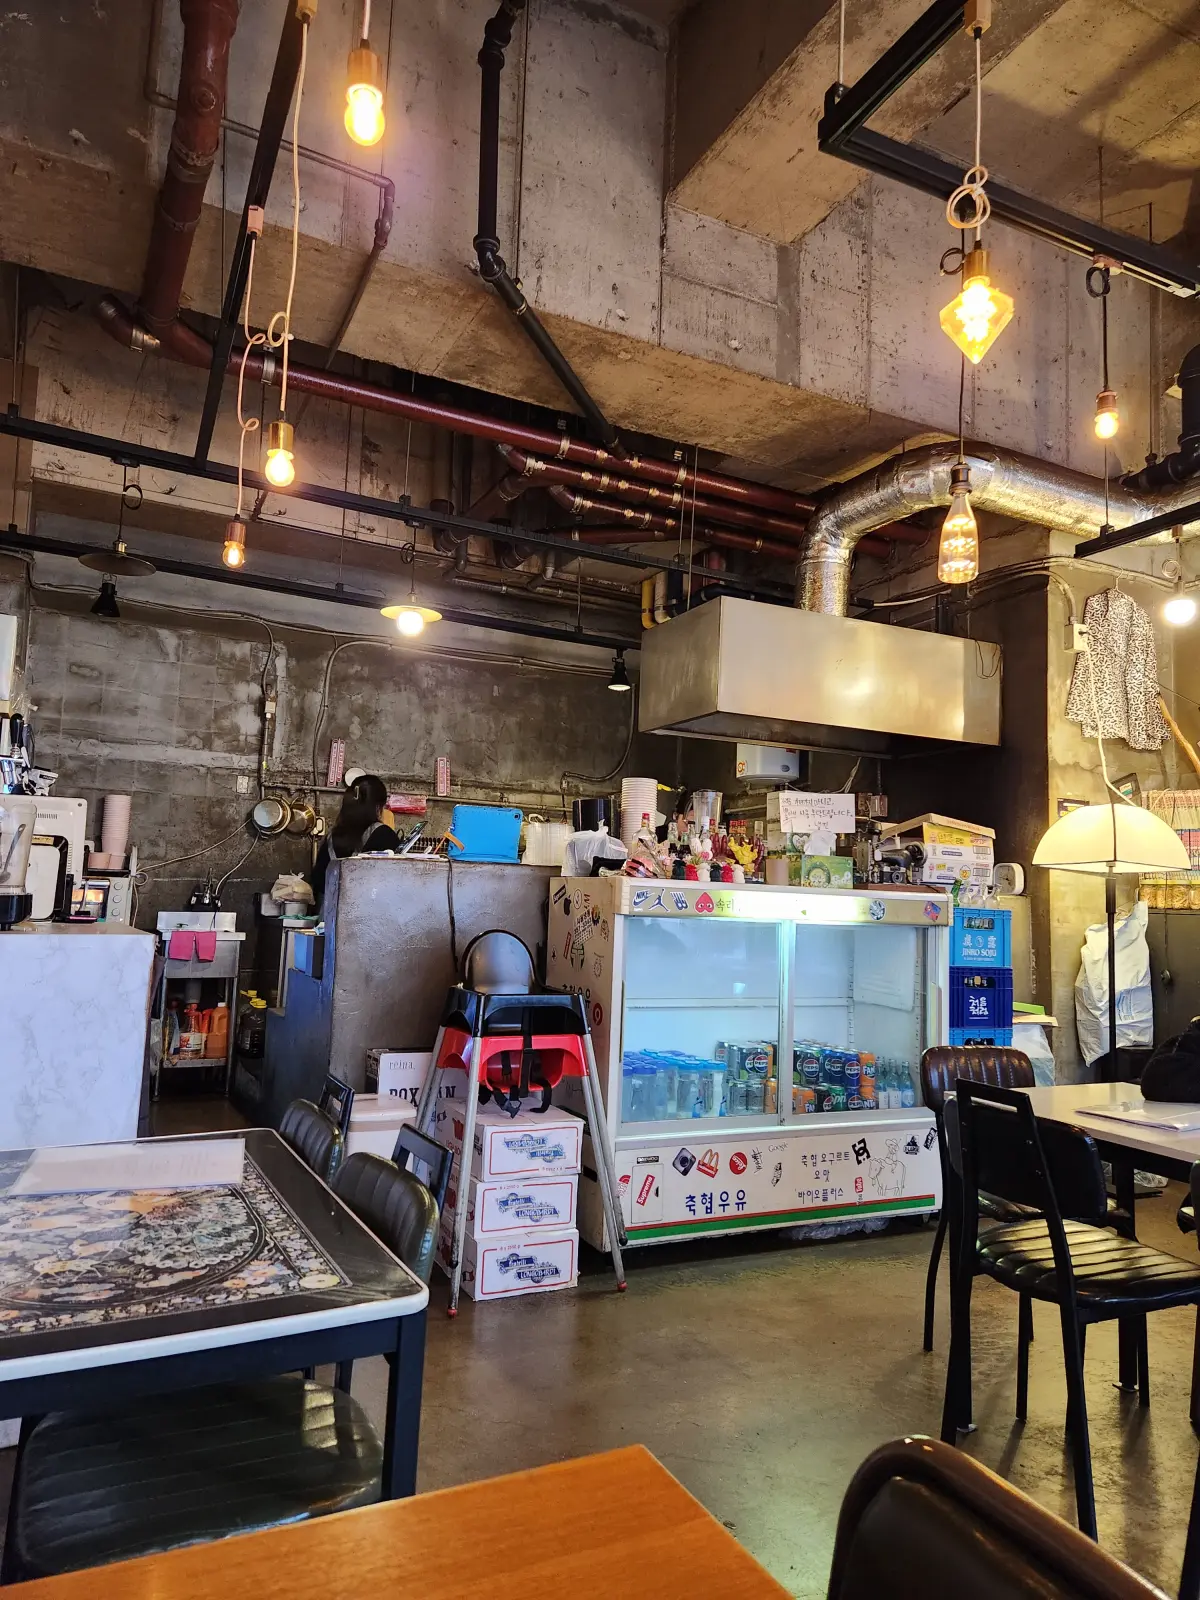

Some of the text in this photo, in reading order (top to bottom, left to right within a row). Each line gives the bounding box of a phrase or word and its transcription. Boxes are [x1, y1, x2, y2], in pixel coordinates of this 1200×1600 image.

[635, 890, 649, 900] NIKE
[637, 1175, 654, 1205] Supreme
[797, 1187, 844, 1205] 바이오플러스
[685, 1189, 747, 1216] 축협우유
